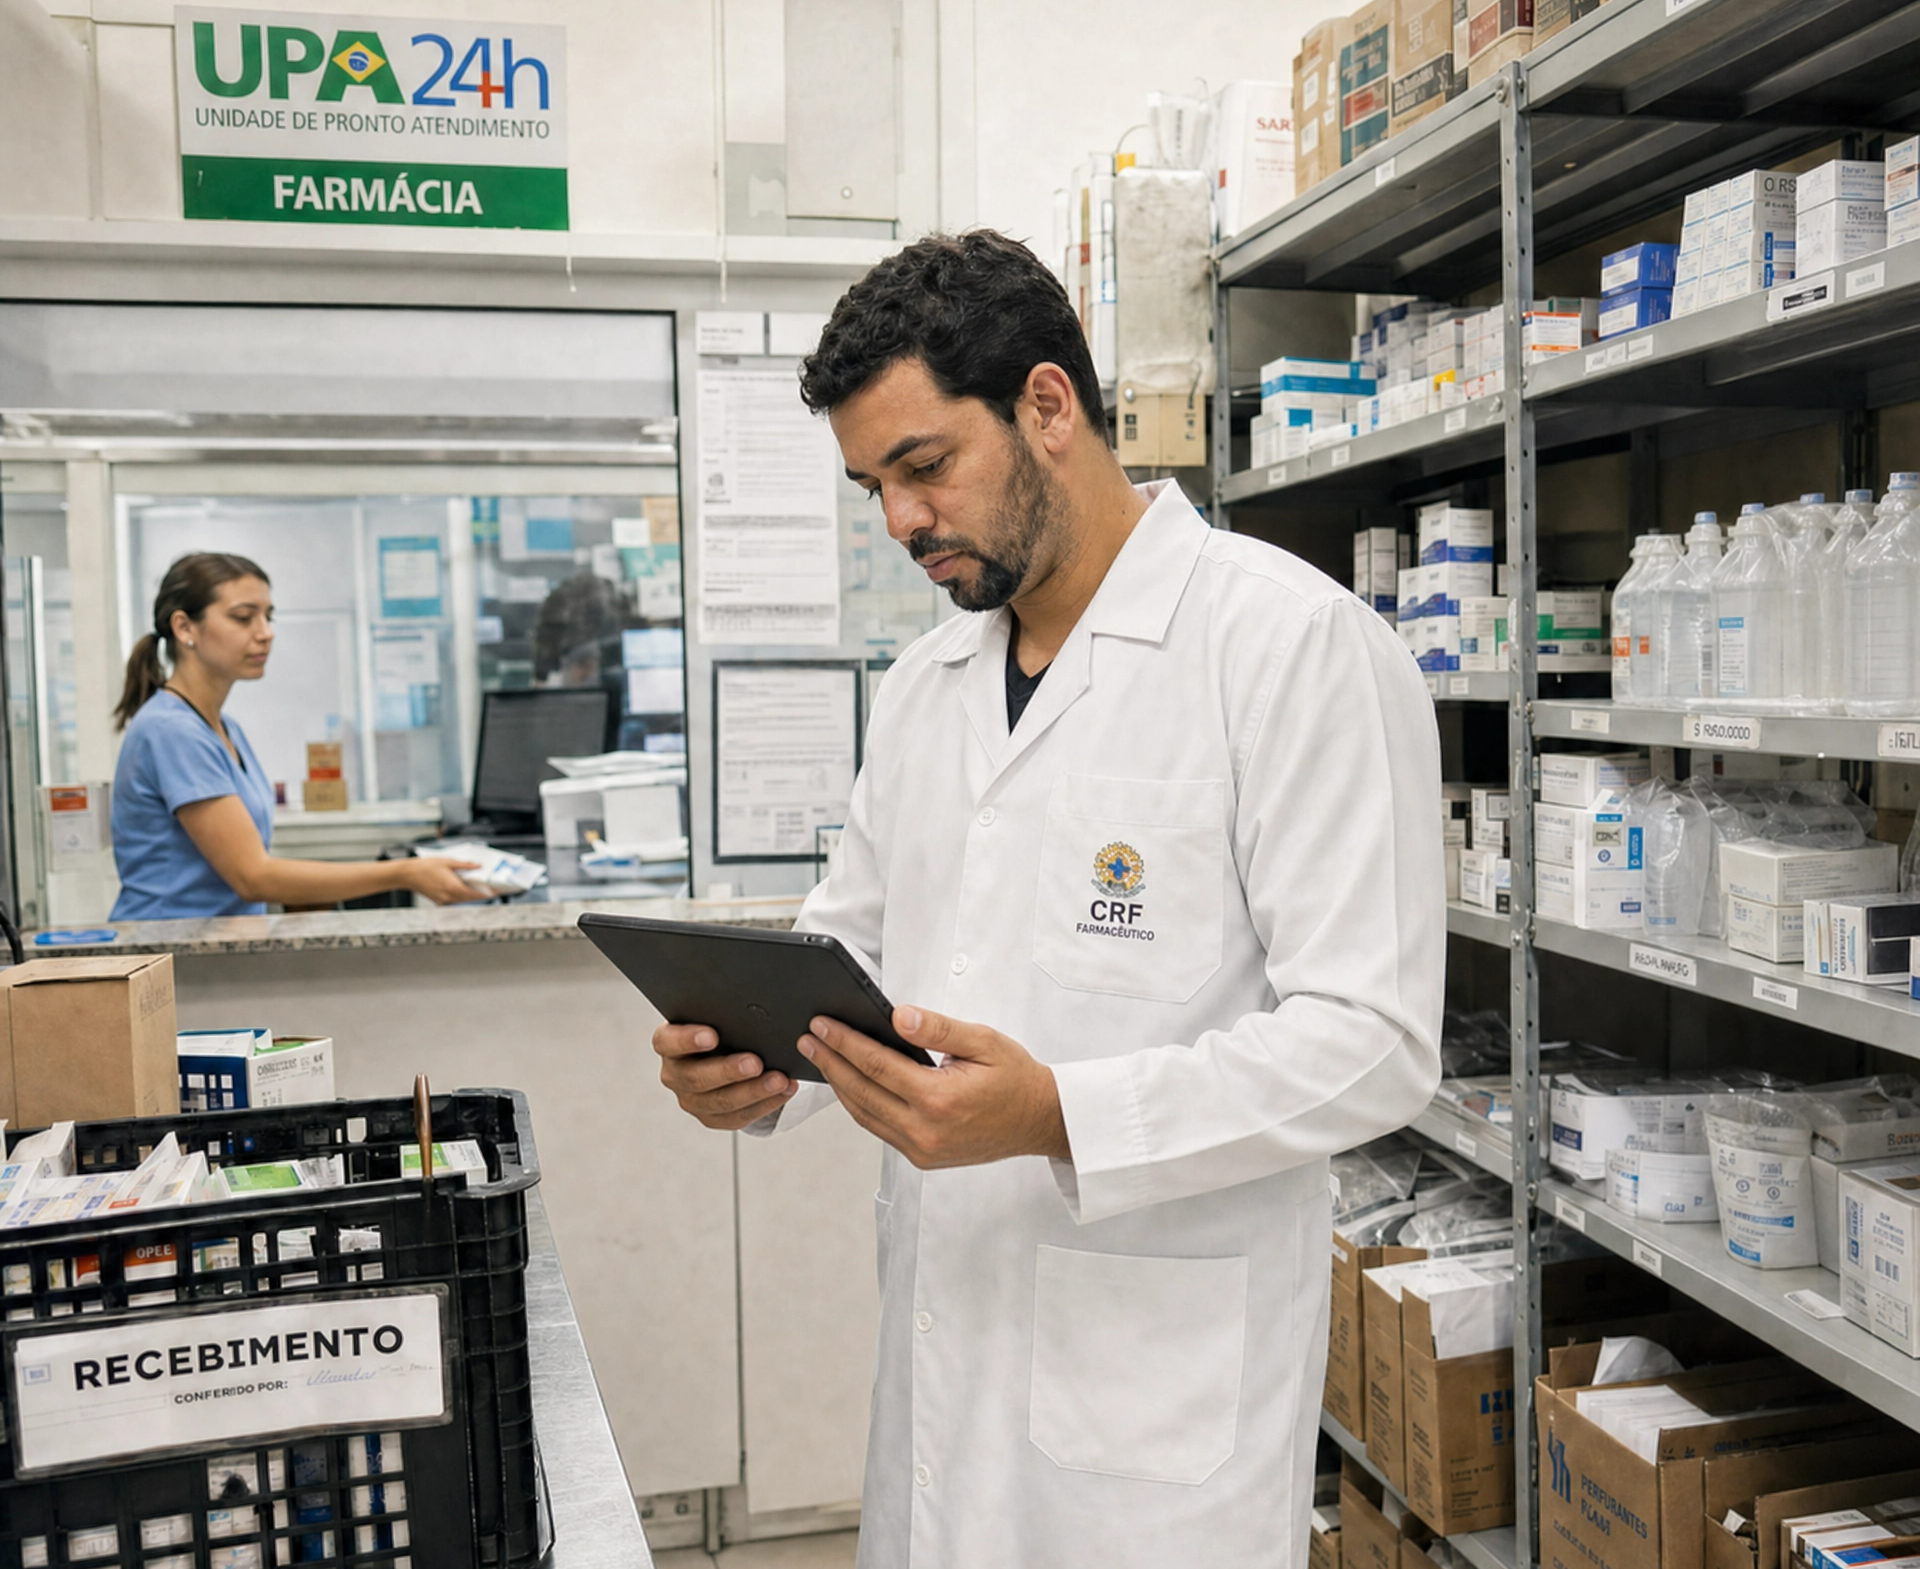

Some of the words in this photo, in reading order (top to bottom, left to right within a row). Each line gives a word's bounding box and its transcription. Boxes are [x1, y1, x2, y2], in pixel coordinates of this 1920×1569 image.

[193, 21, 406, 105] UPA
[411, 33, 550, 110] 24h
[195, 107, 286, 130] UNIDADE
[292, 111, 318, 131] DE
[325, 113, 405, 134] PRONTO
[411, 117, 550, 139] ATENDIMENTO
[273, 172, 483, 215] FARMÁCIA
[1090, 900, 1143, 925] CRF
[1076, 922, 1155, 941] FARMACÊUTICO
[136, 1244, 173, 1259] OPEE
[74, 1324, 403, 1391] RECEBIMENTO
[174, 1384, 254, 1404] CONFERIDO
[258, 1380, 288, 1392] POR:
[1581, 1474, 1648, 1540] PERFURANTES
